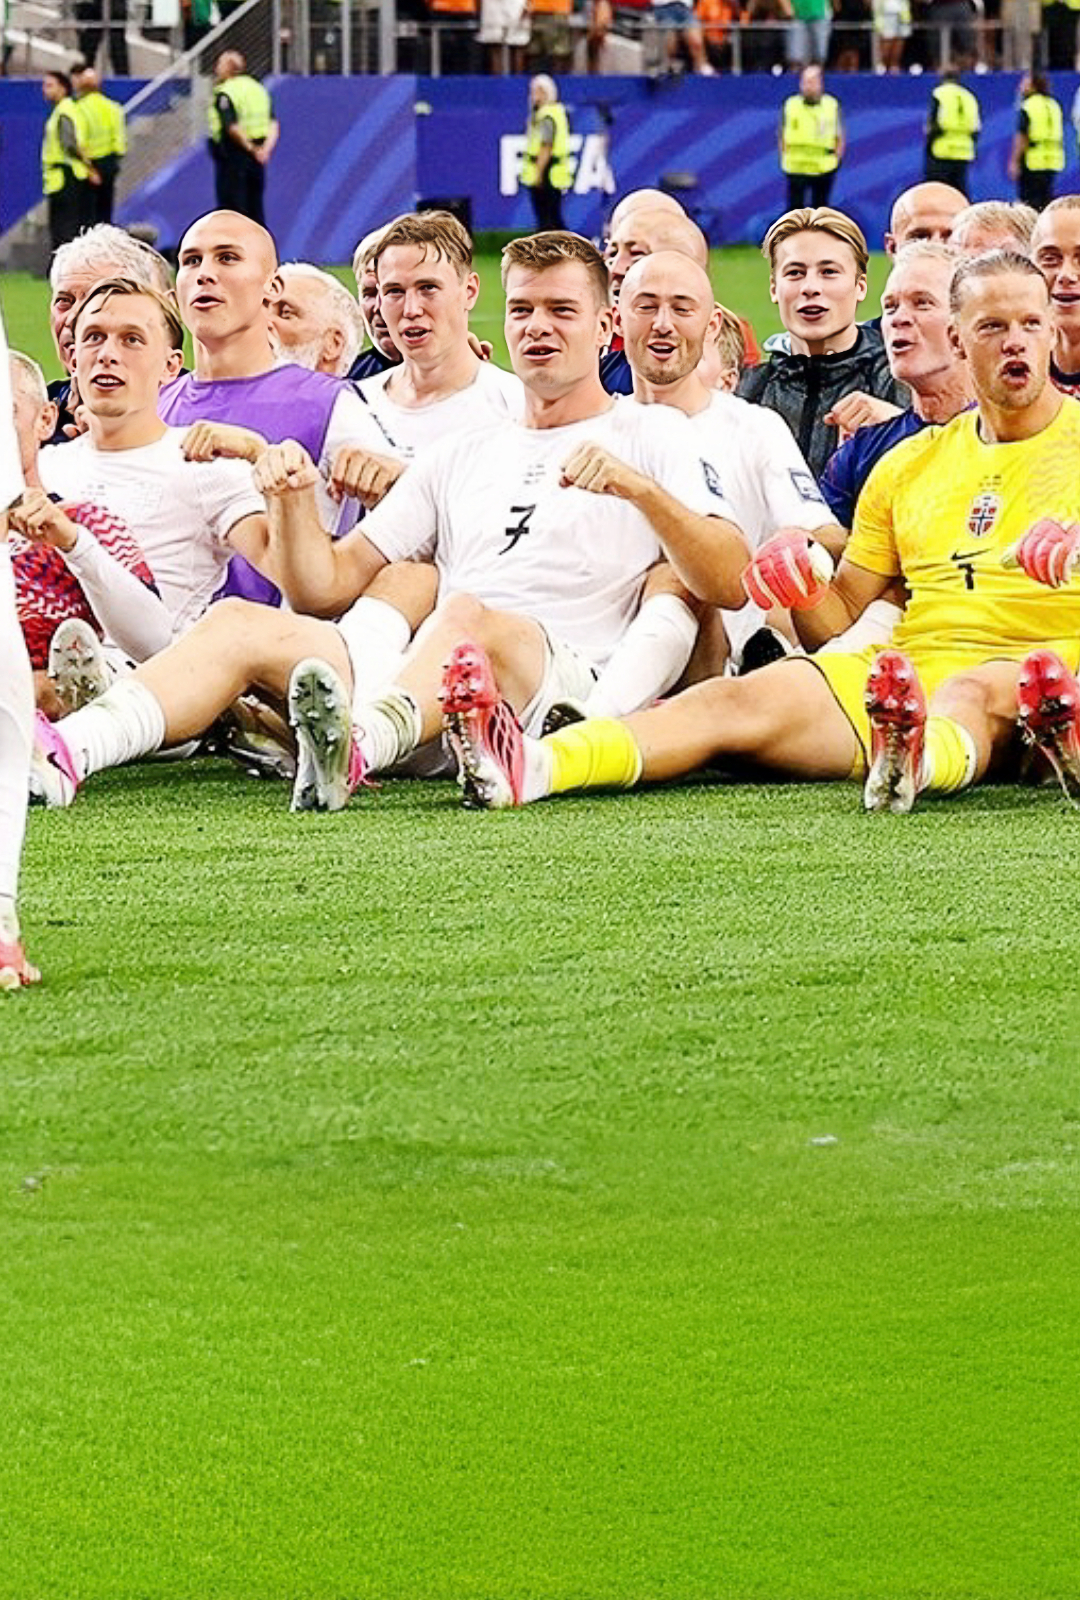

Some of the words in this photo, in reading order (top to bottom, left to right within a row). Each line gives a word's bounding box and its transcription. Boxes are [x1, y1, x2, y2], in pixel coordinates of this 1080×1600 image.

[499, 133, 617, 196] FA
[498, 503, 536, 556] 7
[957, 562, 976, 590] 1
